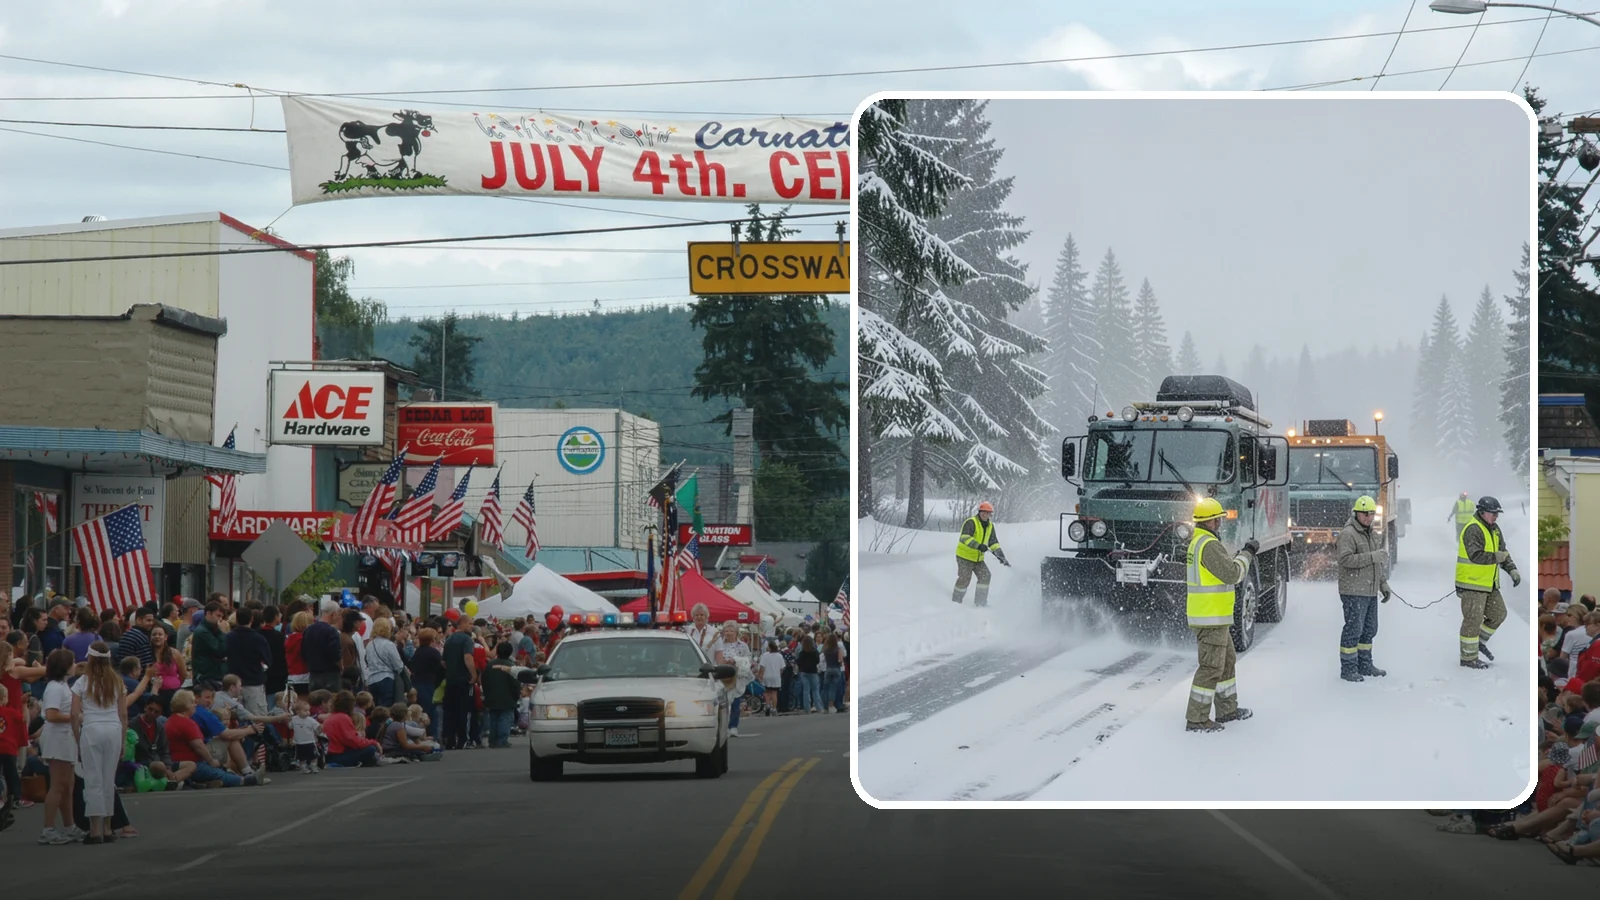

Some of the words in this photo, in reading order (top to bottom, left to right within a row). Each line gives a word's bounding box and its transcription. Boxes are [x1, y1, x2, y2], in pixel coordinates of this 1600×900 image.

[481, 141, 605, 192] JULY
[632, 150, 746, 198] 4th.
[696, 253, 850, 280] CROSSWA
[283, 380, 373, 420] ACE
[405, 408, 452, 422] CEDAR
[284, 421, 370, 436] Hardware
[416, 428, 477, 446] Coca-Cola
[353, 467, 386, 481] Simpl
[83, 485, 93, 494] St.
[95, 486, 124, 495] Vincent
[126, 486, 136, 495] de
[138, 486, 155, 495] Paul
[688, 526, 741, 535] CRNATION
[699, 535, 730, 543] GLASS
